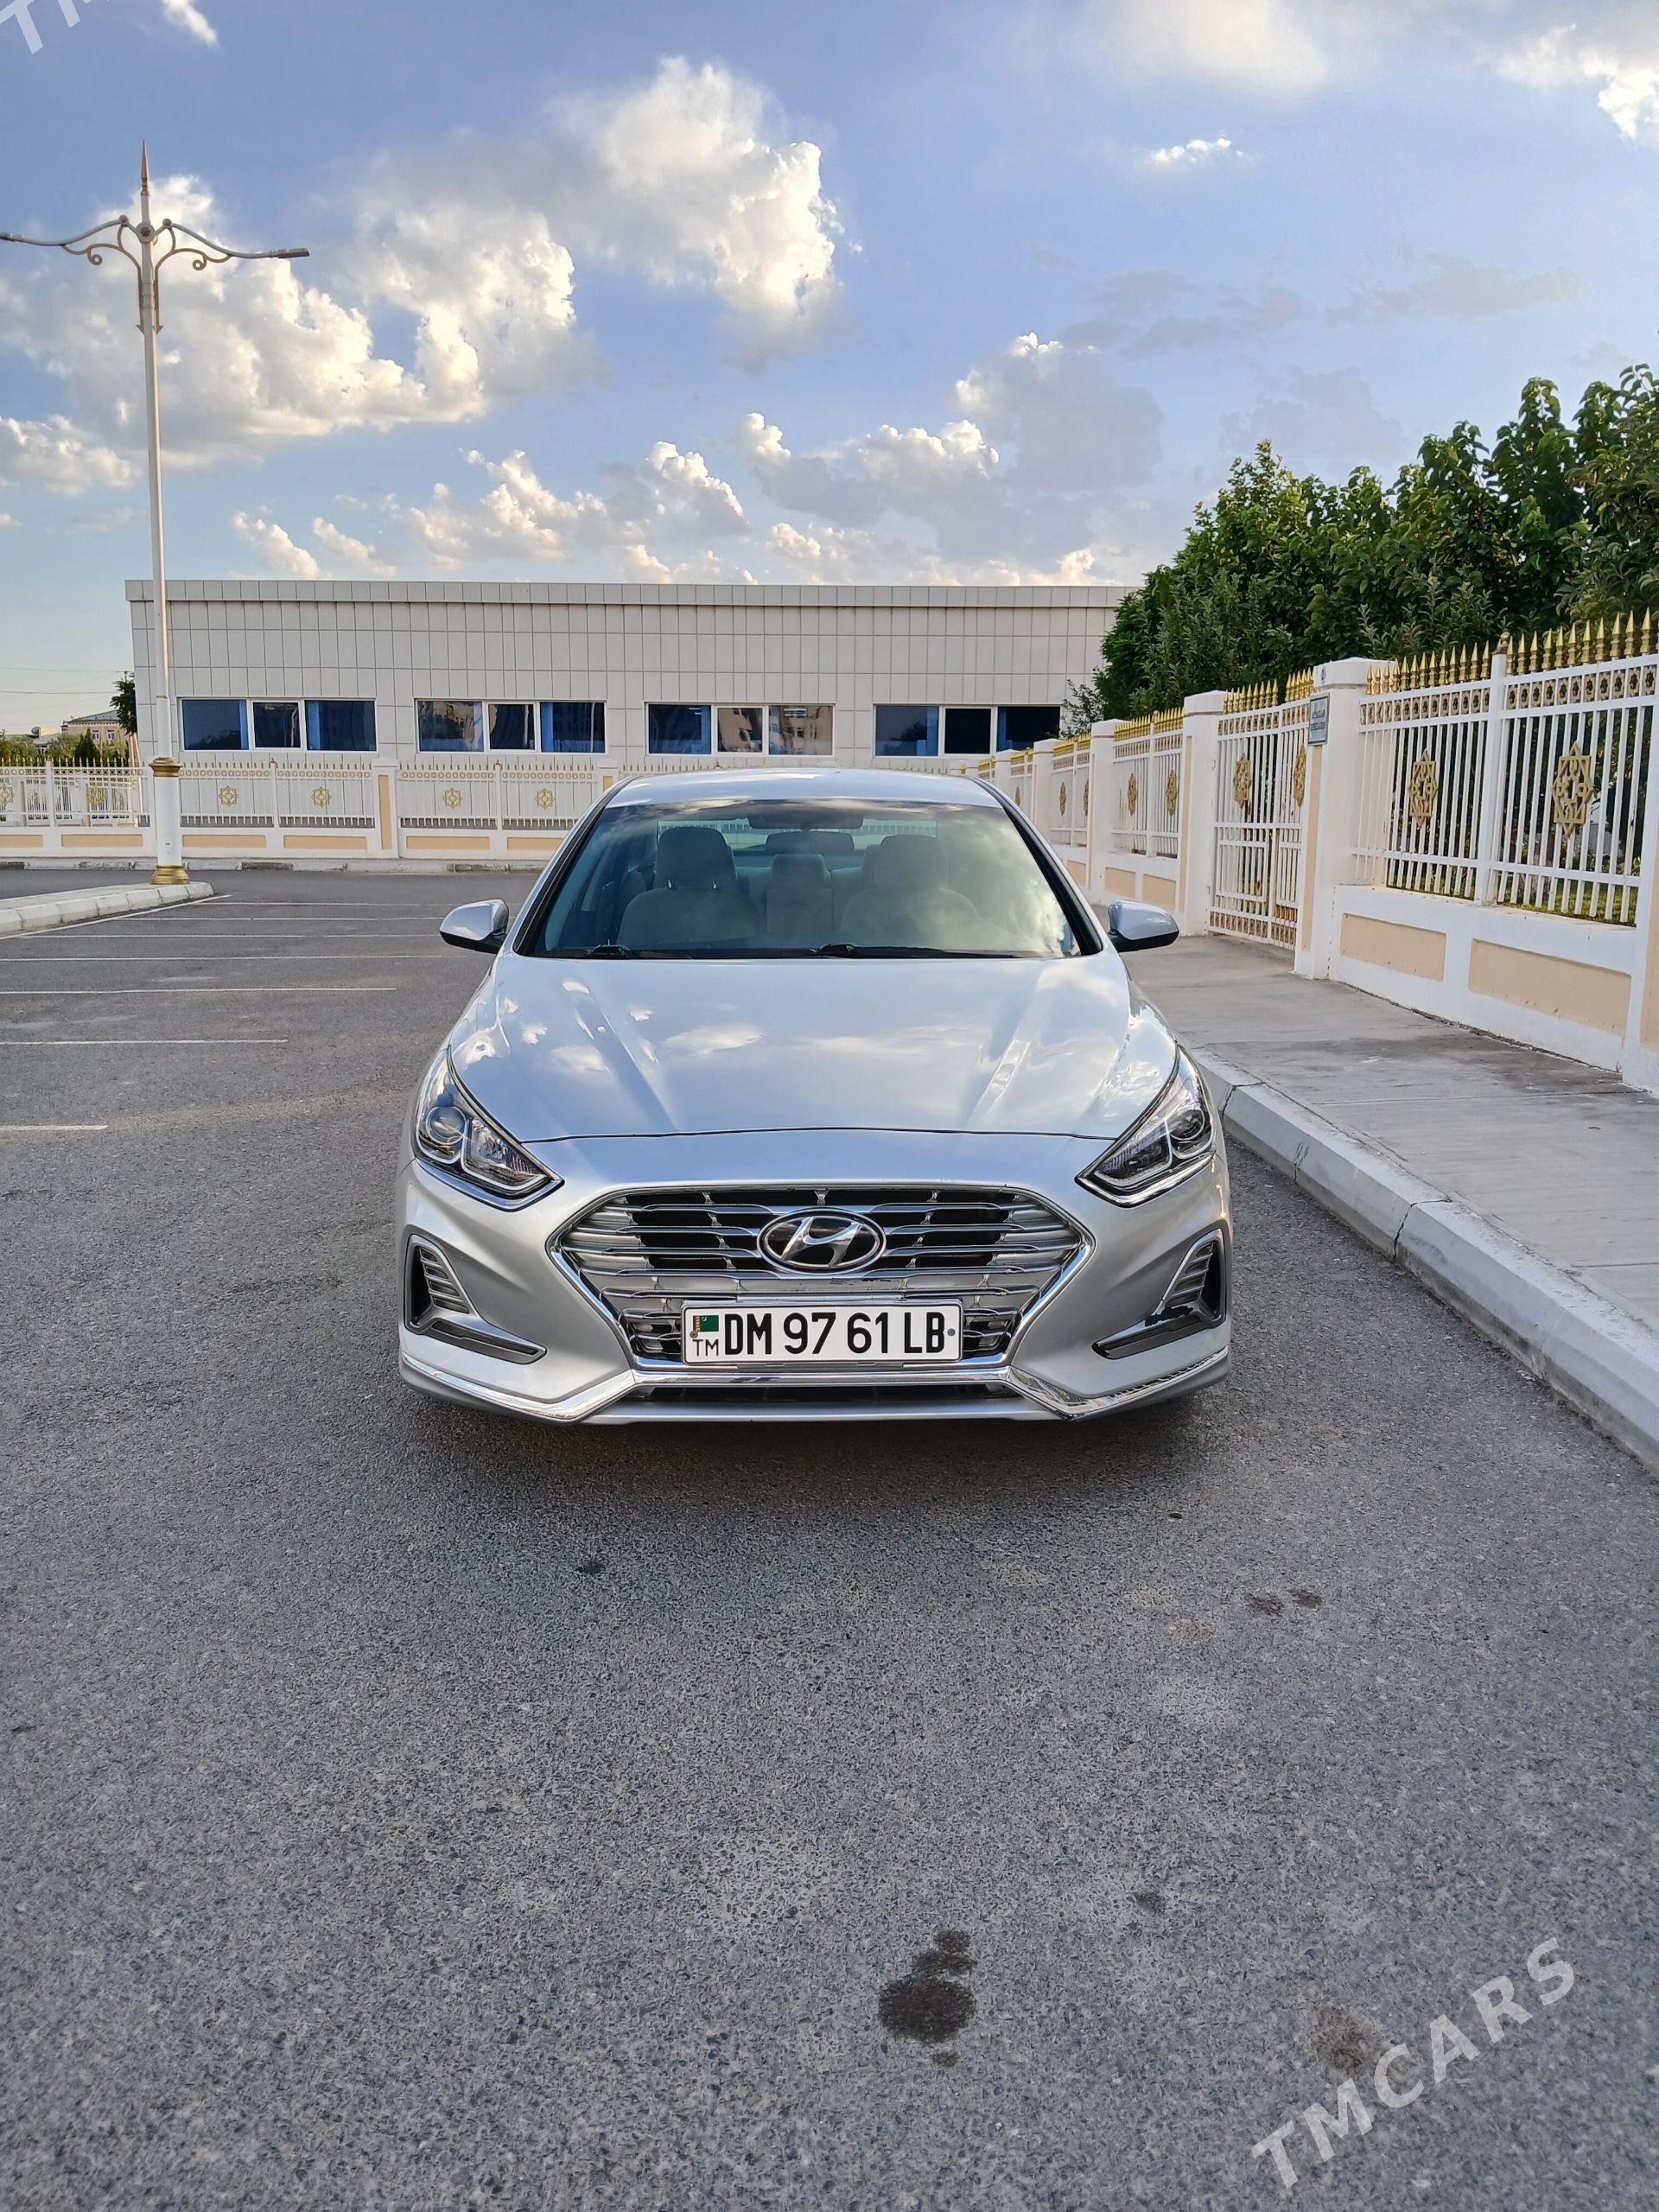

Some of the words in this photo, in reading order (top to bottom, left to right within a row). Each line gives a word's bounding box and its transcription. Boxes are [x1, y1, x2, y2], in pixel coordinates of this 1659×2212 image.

[692, 1338, 719, 1357] TM
[724, 1313, 772, 1355] DM
[784, 1312, 836, 1354] 97
[847, 1312, 888, 1354] 61
[904, 1312, 944, 1354] LB
